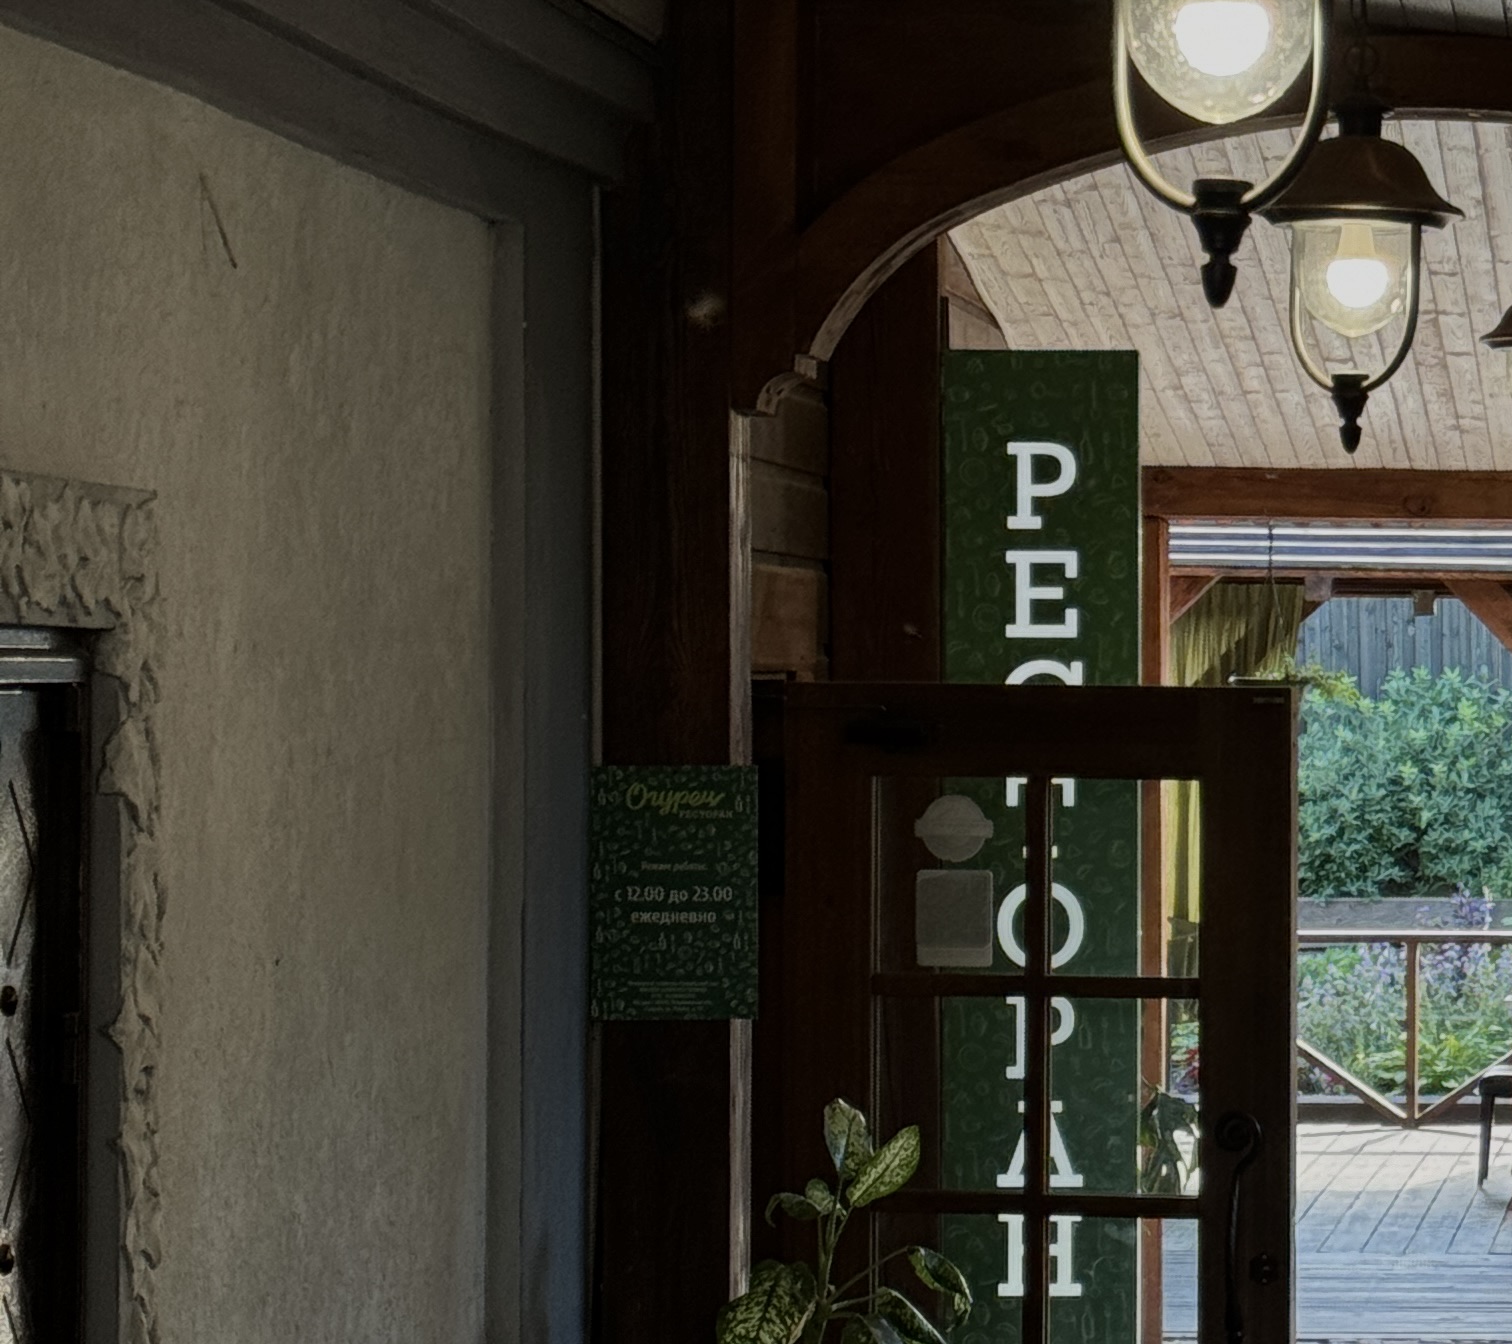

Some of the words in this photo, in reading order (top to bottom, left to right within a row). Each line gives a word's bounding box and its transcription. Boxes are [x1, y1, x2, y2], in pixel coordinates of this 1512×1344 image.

[625, 782, 726, 816] Огурец
[997, 442, 1084, 1297] РЕОРАН
[614, 889, 623, 902] с
[626, 886, 665, 902] 12.00
[667, 889, 688, 905] до
[692, 886, 733, 902] 23.00
[631, 911, 717, 926] ежедневно
